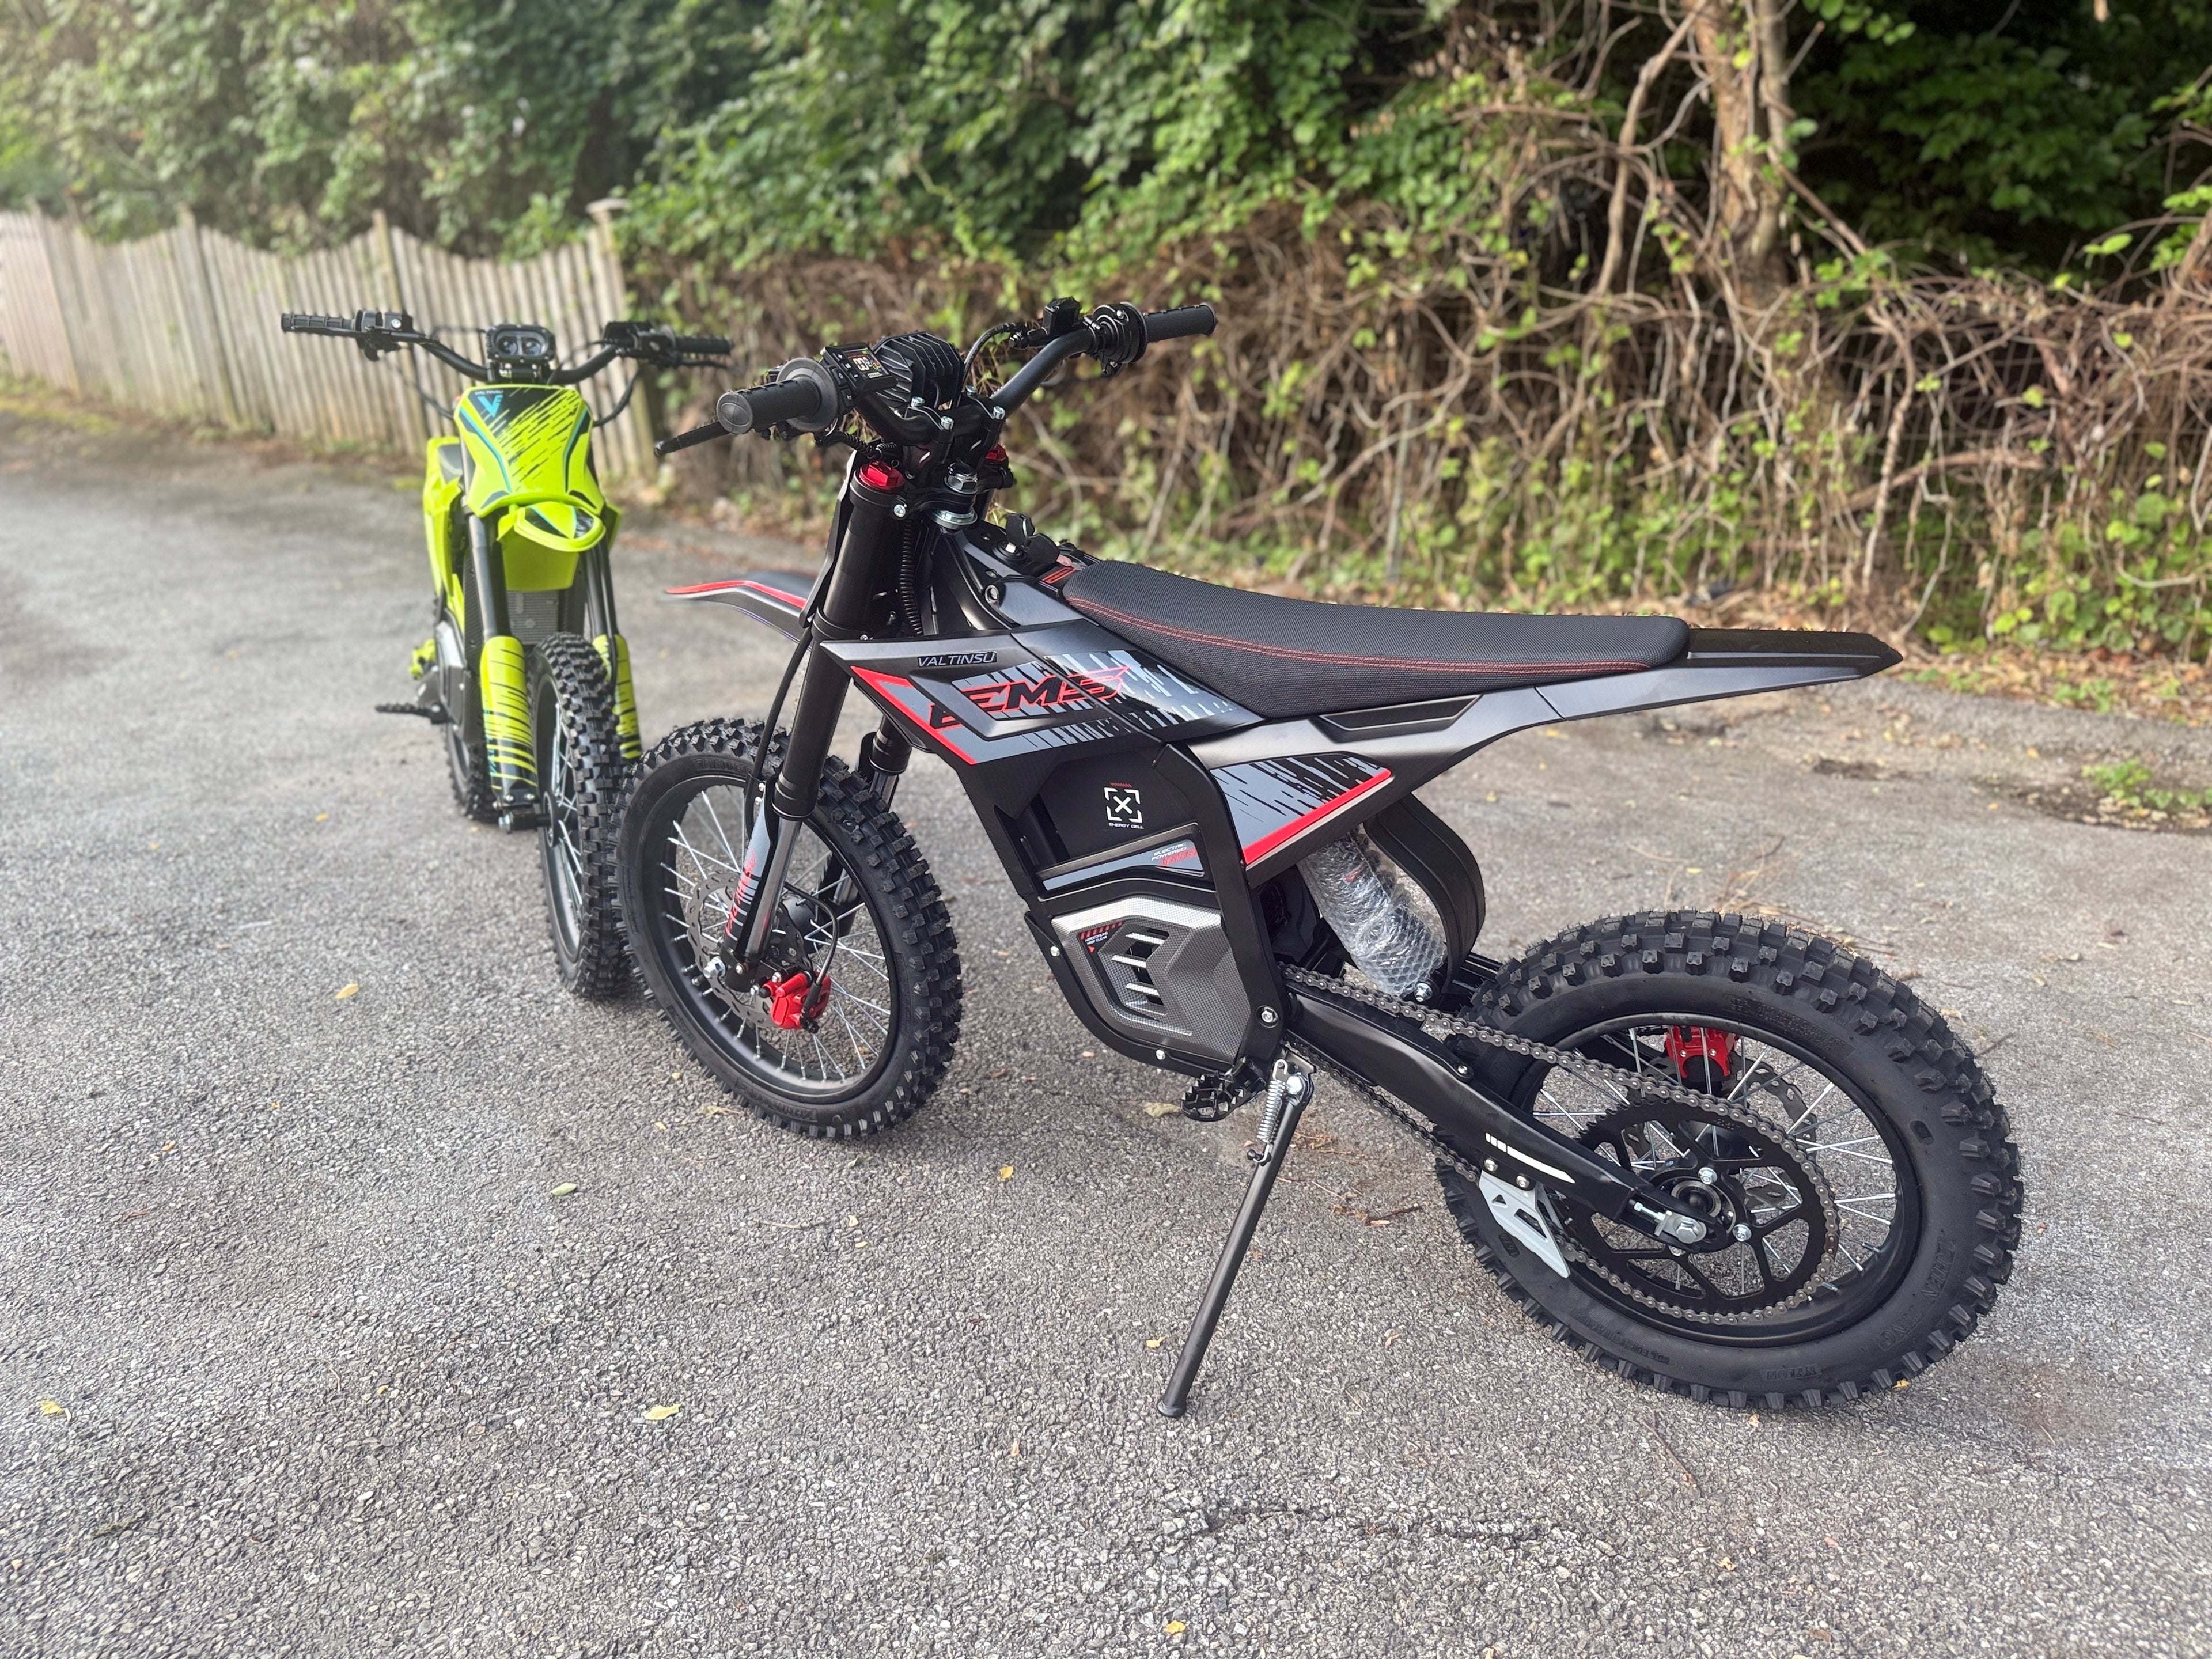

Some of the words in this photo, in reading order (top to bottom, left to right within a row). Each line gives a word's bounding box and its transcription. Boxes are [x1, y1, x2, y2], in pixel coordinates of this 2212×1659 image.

[918, 652, 995, 667] VALTINSU
[1152, 846, 1187, 861] POWERED
[1154, 842, 1187, 856] ELECTRIC
[1766, 1365, 1816, 1381] NYLON
